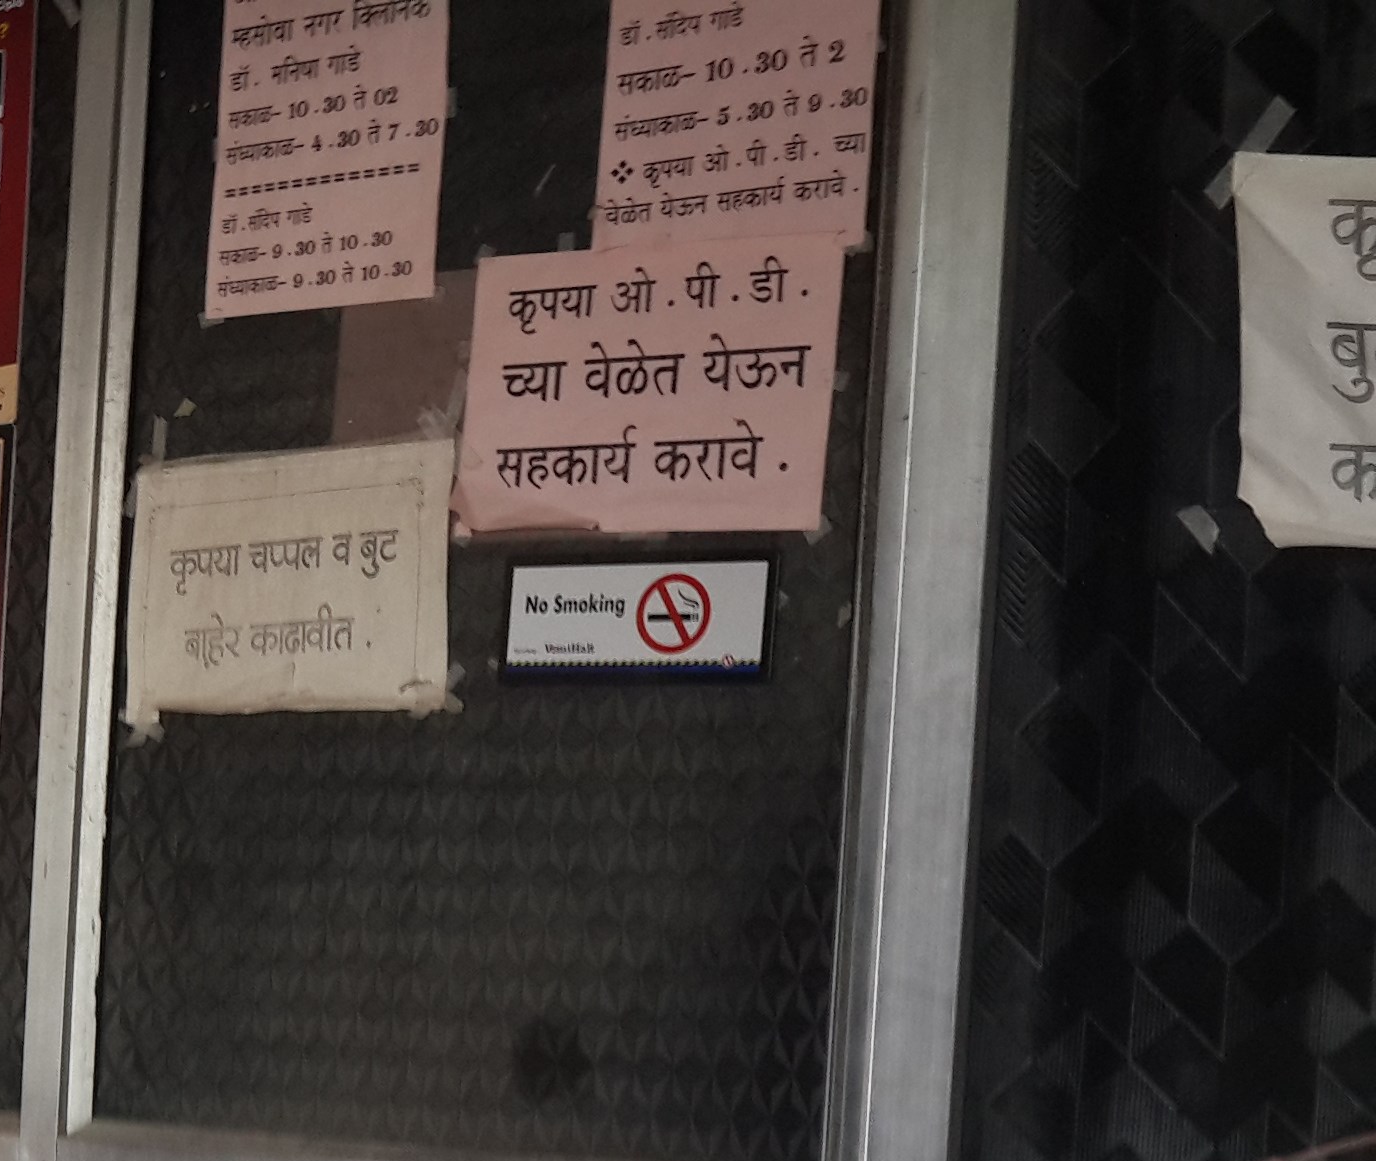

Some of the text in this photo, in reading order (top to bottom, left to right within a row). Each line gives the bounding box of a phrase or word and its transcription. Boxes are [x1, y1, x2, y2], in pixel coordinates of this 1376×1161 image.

[303, 11, 345, 37] नगर
[828, 39, 846, 64] 2
[374, 87, 398, 106] 02
[642, 155, 696, 190] कृपया
[660, 192, 709, 219] येऊन
[717, 175, 784, 215] सहकार्य
[508, 284, 597, 334] कृपया
[503, 333, 811, 402] च्या वेळेत येऊन
[496, 425, 637, 489] सहकार्य
[169, 529, 399, 596] कृपया चप्पल व बुट
[525, 593, 626, 618] No Smoking
[184, 612, 242, 670] बाहेर
